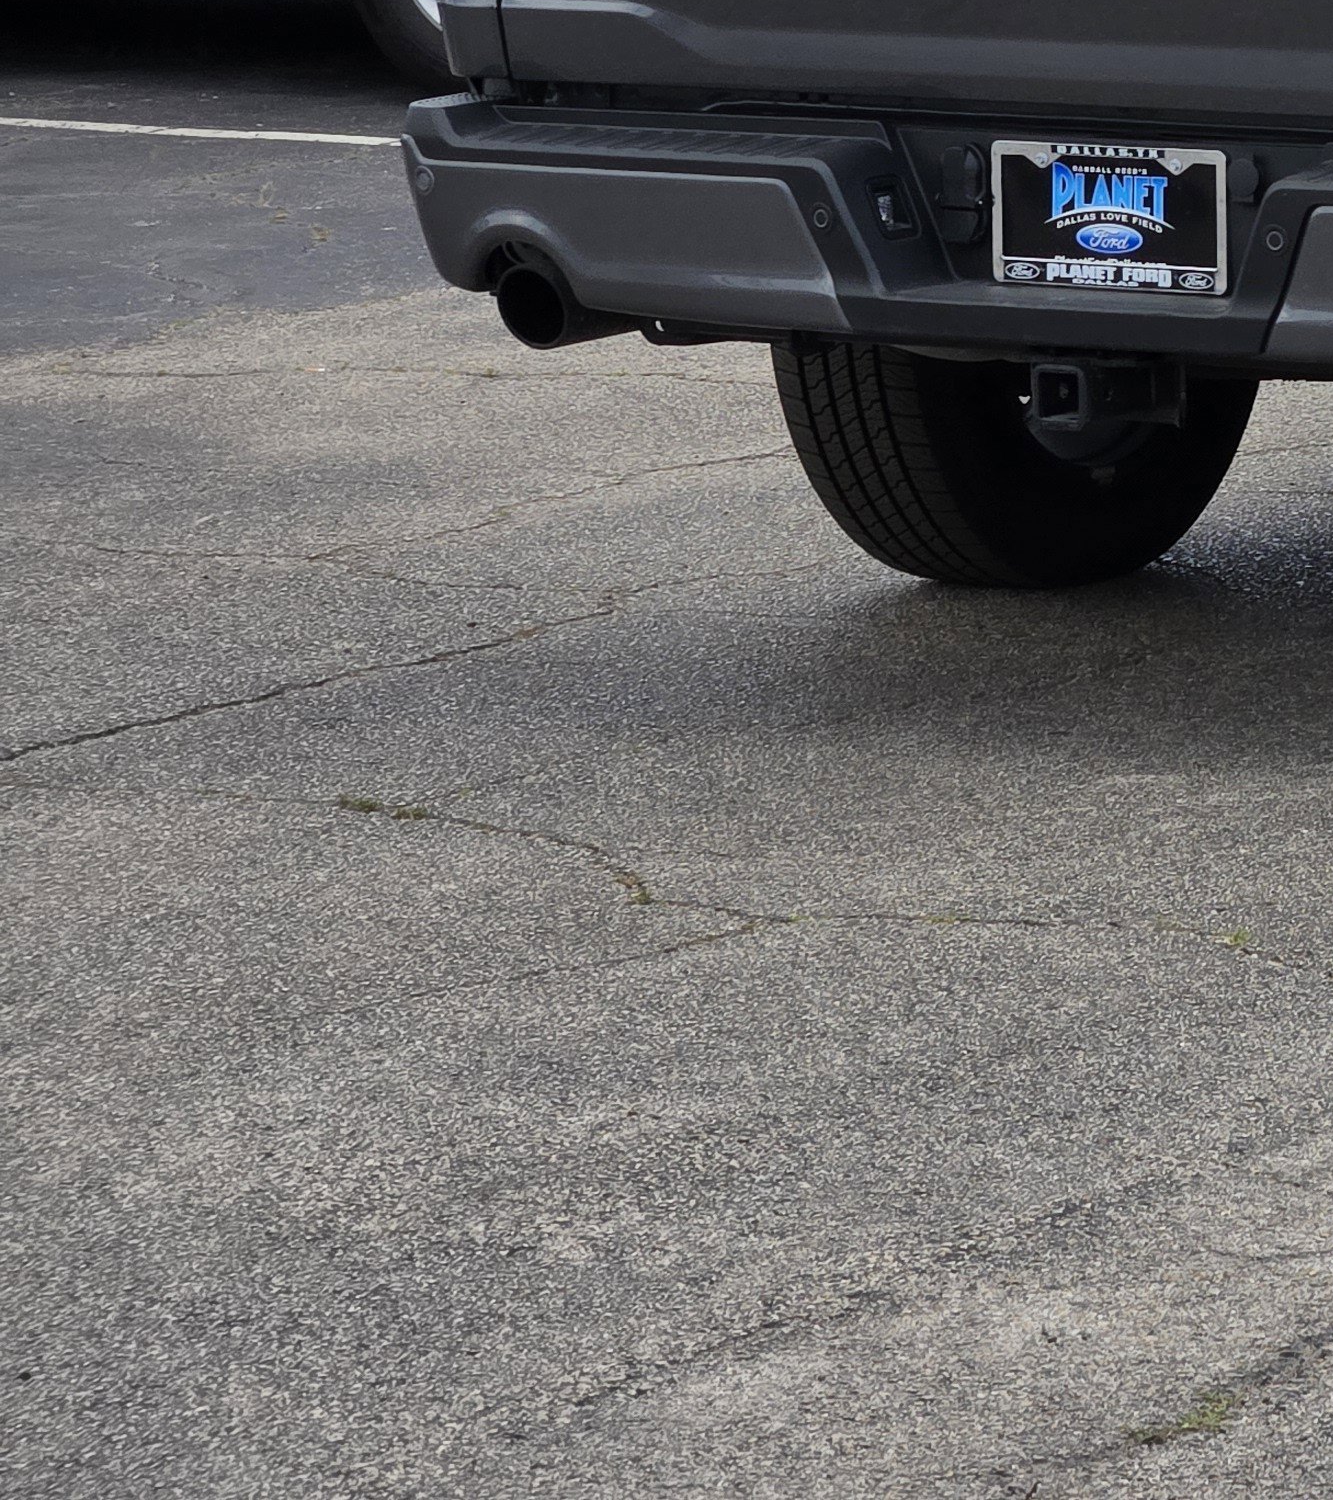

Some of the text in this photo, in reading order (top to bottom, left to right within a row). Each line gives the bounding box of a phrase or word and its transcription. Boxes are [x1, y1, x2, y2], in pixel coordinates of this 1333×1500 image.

[1052, 161, 1168, 222] PLANET
[1057, 213, 1163, 233] DALLAS LOVE FIELD
[1090, 229, 1129, 249] Ford
[1046, 263, 1173, 288] PLANET FORD
[1072, 278, 1139, 287] DALLAS
